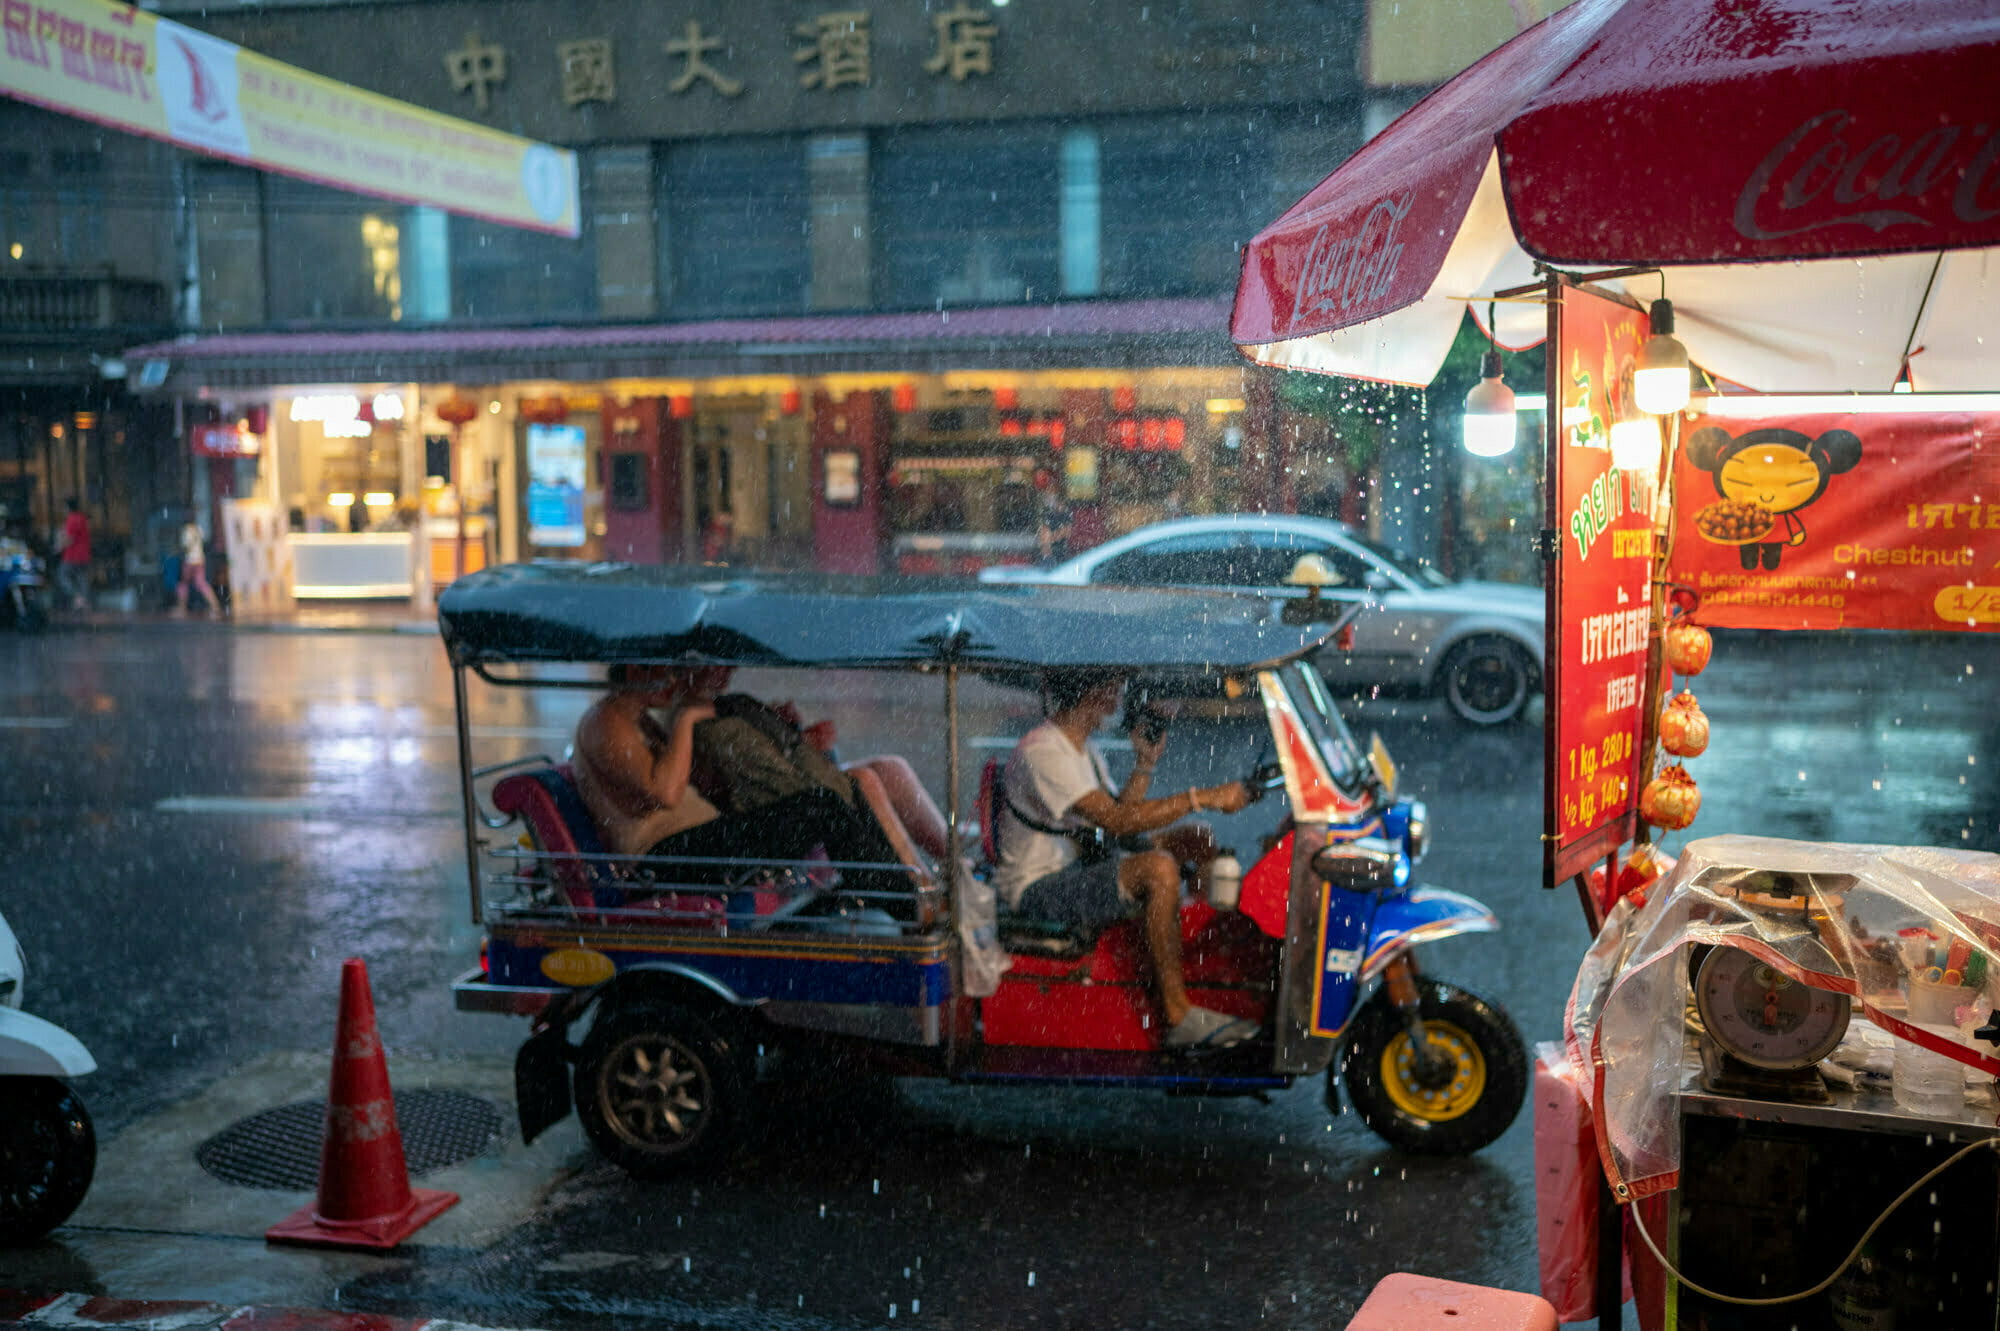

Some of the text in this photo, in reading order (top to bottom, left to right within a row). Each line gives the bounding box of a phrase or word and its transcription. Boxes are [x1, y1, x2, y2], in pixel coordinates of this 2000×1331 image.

[443, 4, 998, 111] 中國大酒店
[1734, 107, 2000, 241] Coca-C
[1290, 189, 1417, 323] Coca-Cola
[1570, 464, 1623, 562] หยก
[1833, 543, 1974, 566] Chestnut
[1569, 748, 1576, 781] 1
[1580, 743, 1599, 783] kg.
[1601, 731, 1624, 768] 280
[1579, 789, 1597, 828] kg.
[1601, 775, 1620, 812] 140
